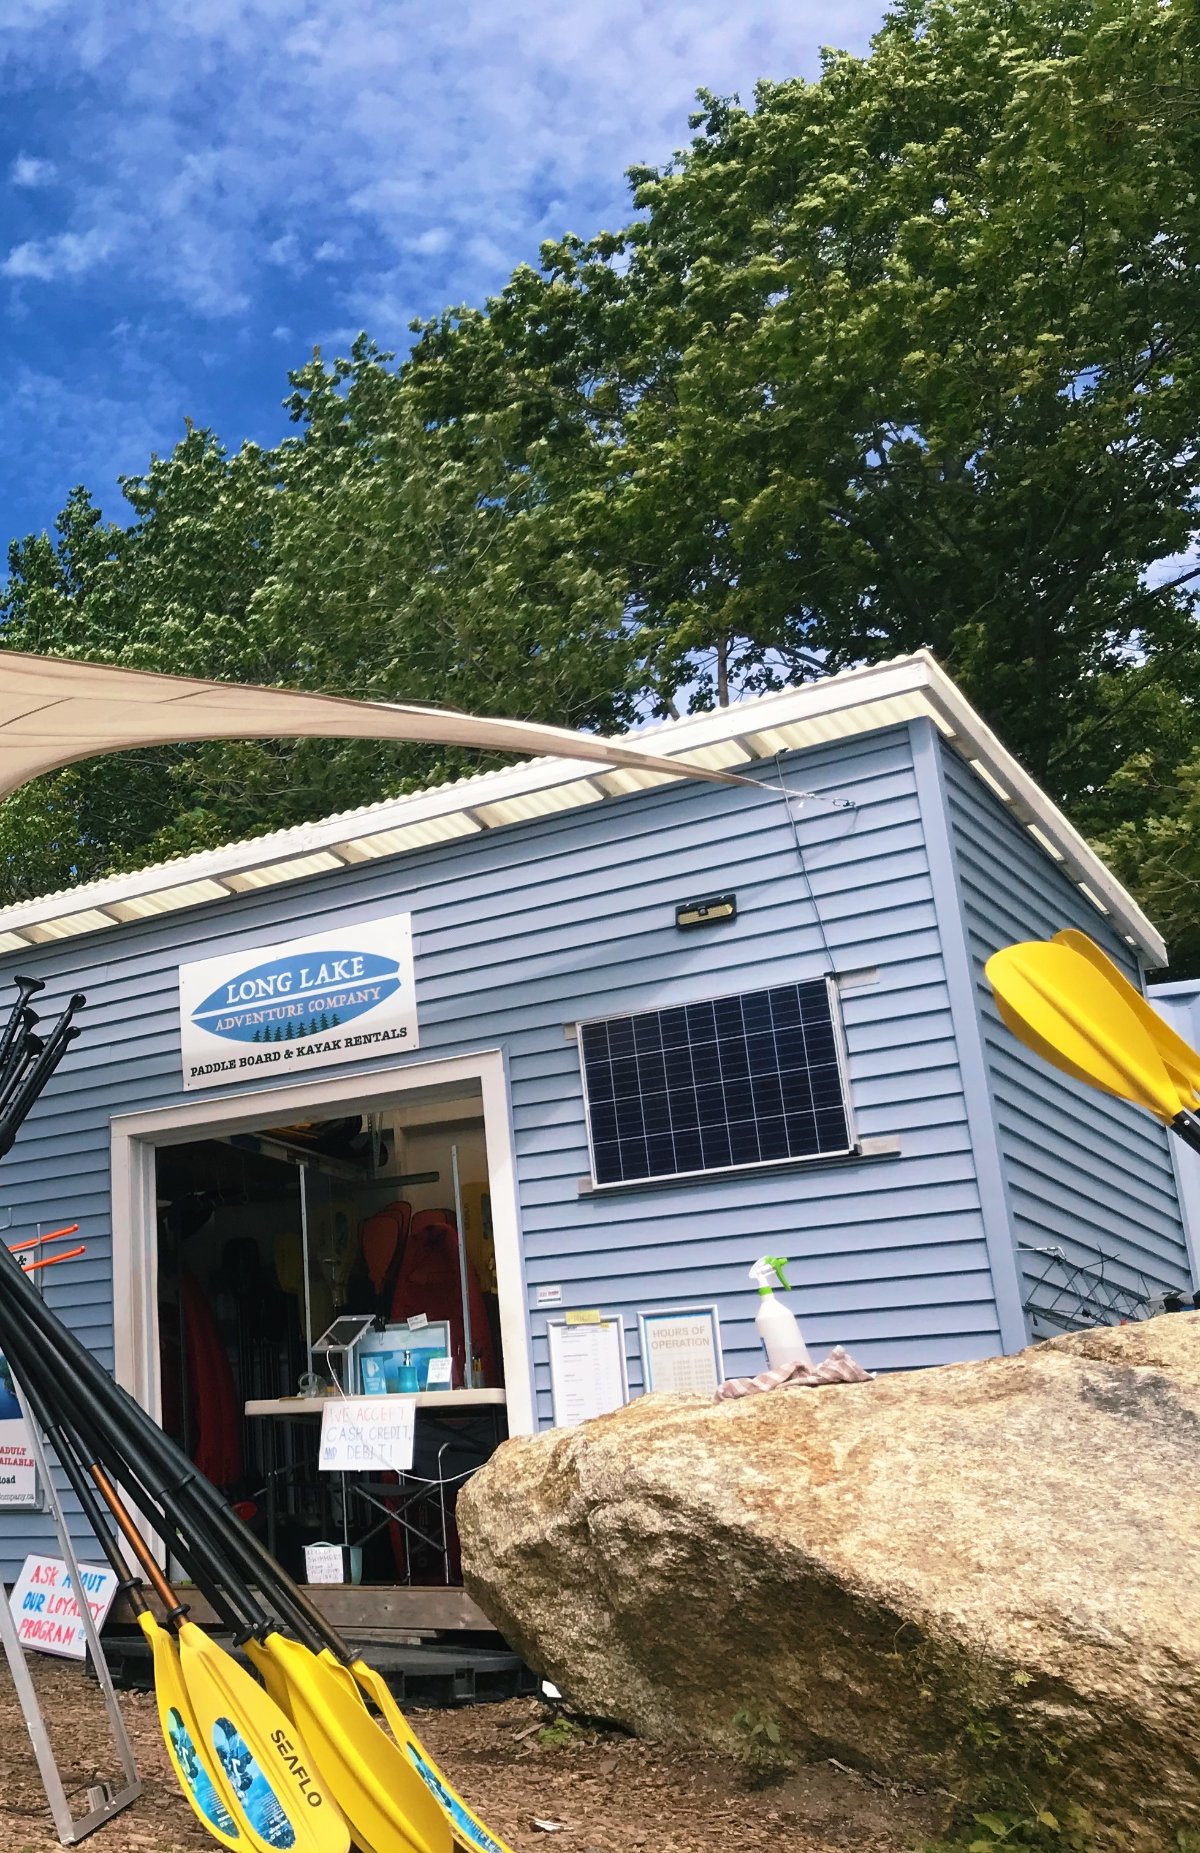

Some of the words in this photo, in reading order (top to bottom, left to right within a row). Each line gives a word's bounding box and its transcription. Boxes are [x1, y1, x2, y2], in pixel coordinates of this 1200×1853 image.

[226, 972, 292, 1004] LONG
[300, 956, 364, 987] LAKE
[215, 1003, 304, 1031] ADVENTURE
[308, 987, 381, 1013] COMPANY
[190, 1059, 236, 1077] PADDLE
[239, 1051, 281, 1068] BOARD
[284, 1049, 294, 1059] &
[296, 1039, 342, 1058] KAYAK
[345, 1027, 408, 1047] RENTALS
[651, 1337, 710, 1350] OPERATION
[653, 1327, 688, 1338] HOURS
[691, 1325, 706, 1336] OF
[356, 1407, 404, 1421] ACCEPT
[0, 1446, 27, 1456] ADULT
[30, 1565, 59, 1587] ASK
[62, 1571, 107, 1593] AOUT
[22, 1591, 45, 1612] OUR
[18, 1618, 75, 1646] PROGRAM
[270, 1729, 322, 1808] SEAFLO
